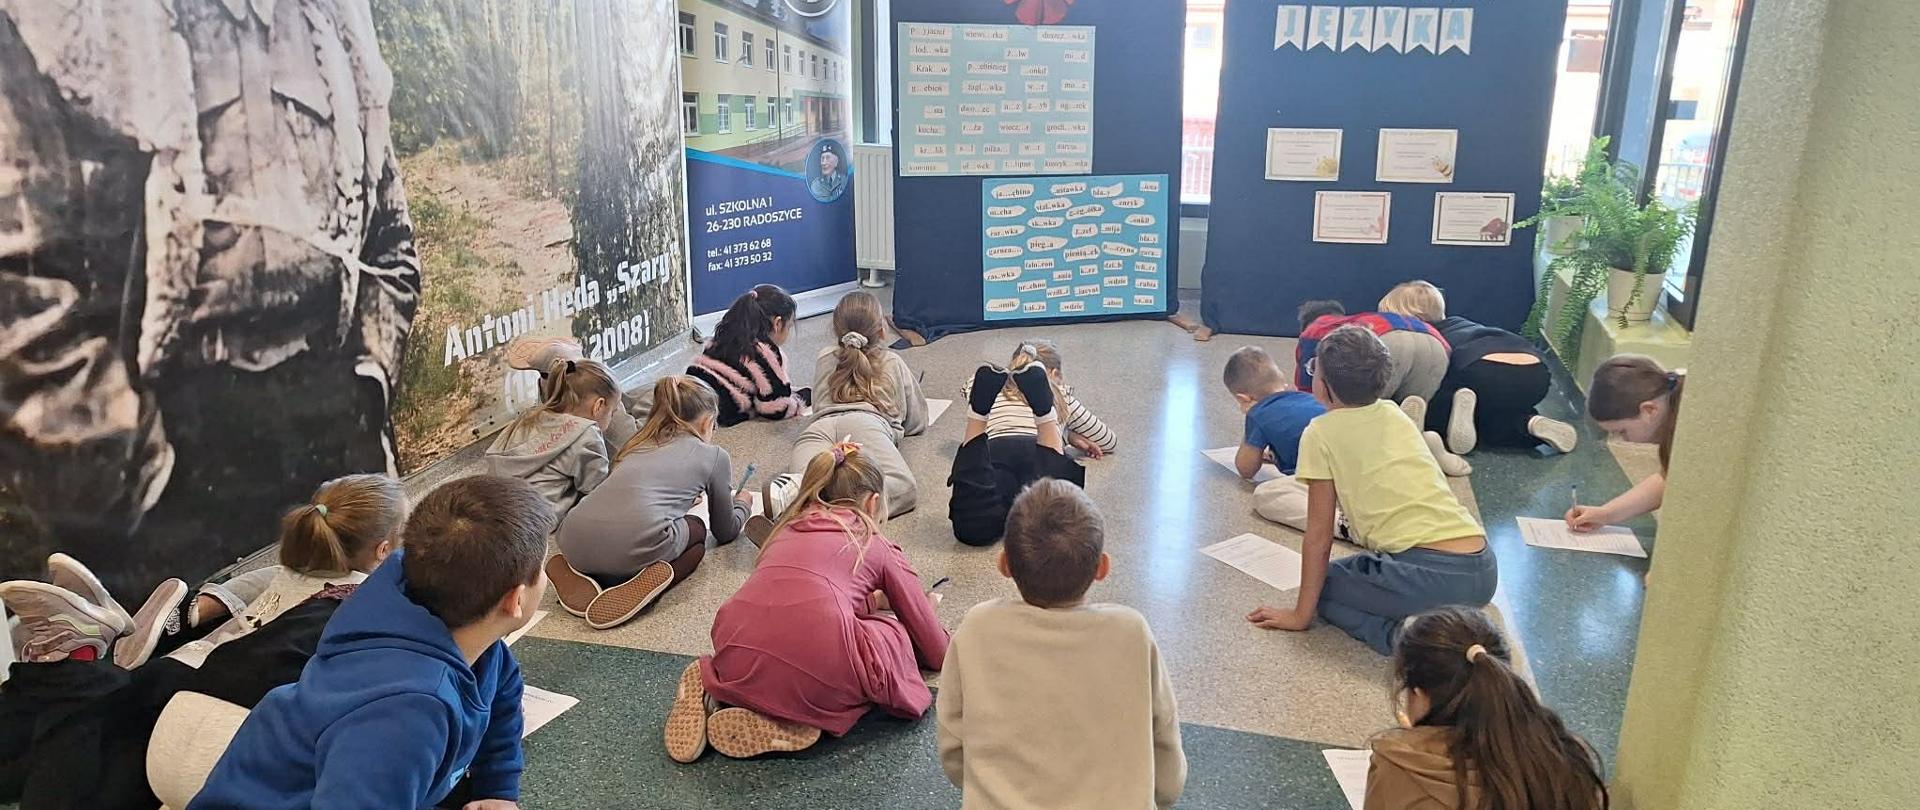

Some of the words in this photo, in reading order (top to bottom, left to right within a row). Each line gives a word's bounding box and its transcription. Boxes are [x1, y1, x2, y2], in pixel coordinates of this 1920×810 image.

[705, 204, 717, 216] ul.
[719, 198, 767, 214] SZKOLNA
[768, 197, 773, 207] 1
[706, 217, 742, 233] 26-230
[743, 208, 802, 227] RADOSZYCE
[707, 247, 722, 258] tel.:
[723, 244, 732, 255] 41
[733, 242, 748, 253] 373
[749, 240, 760, 251] 62
[760, 238, 772, 248] 68
[707, 261, 723, 272] fax:
[724, 258, 733, 268] 41
[734, 255, 750, 267] 373
[750, 253, 761, 264] 50
[761, 251, 773, 262] 32
[444, 296, 536, 367] Antoni
[542, 274, 600, 321] Heda
